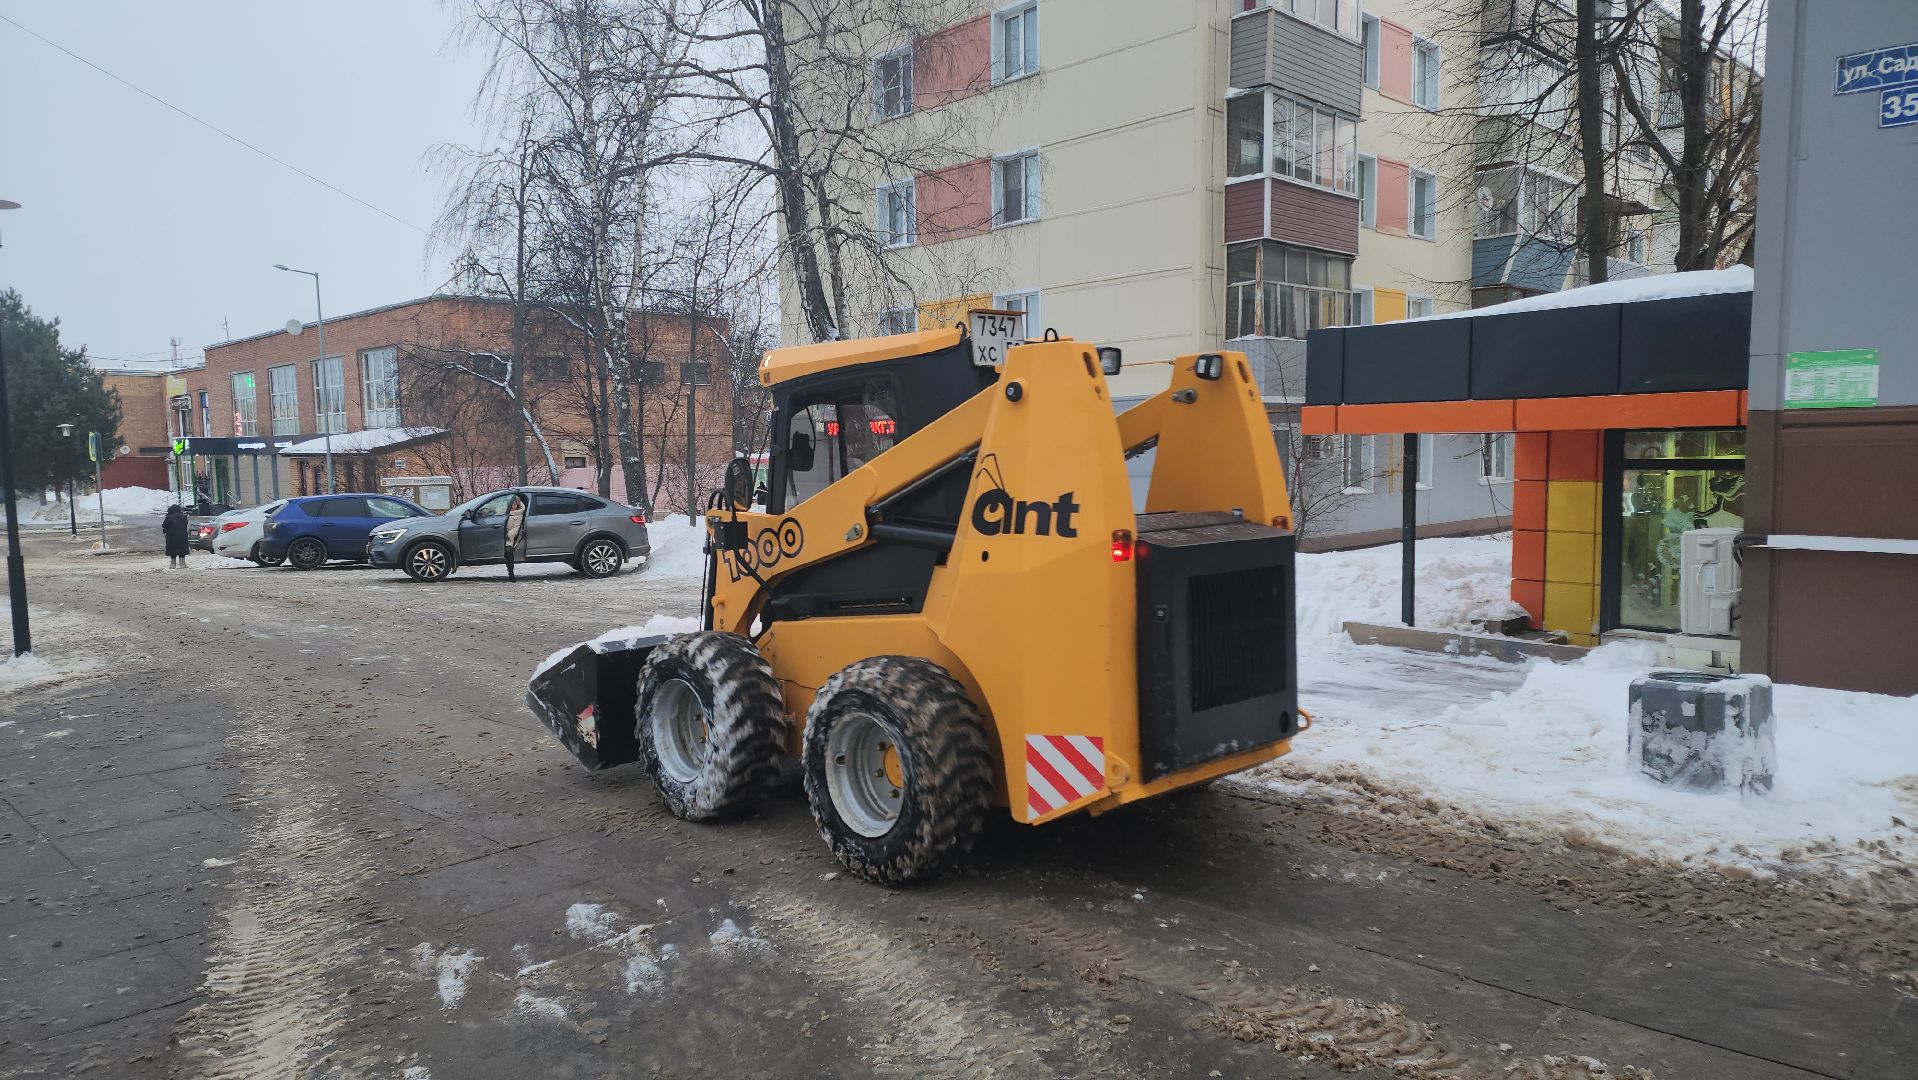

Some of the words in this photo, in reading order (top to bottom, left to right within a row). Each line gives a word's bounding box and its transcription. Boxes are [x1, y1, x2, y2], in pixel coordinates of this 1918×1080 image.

[1883, 93, 1918, 119] 35
[977, 315, 1016, 338] 7347
[978, 346, 997, 362] ХС
[971, 489, 1080, 538] ant
[722, 517, 804, 583] 1000
